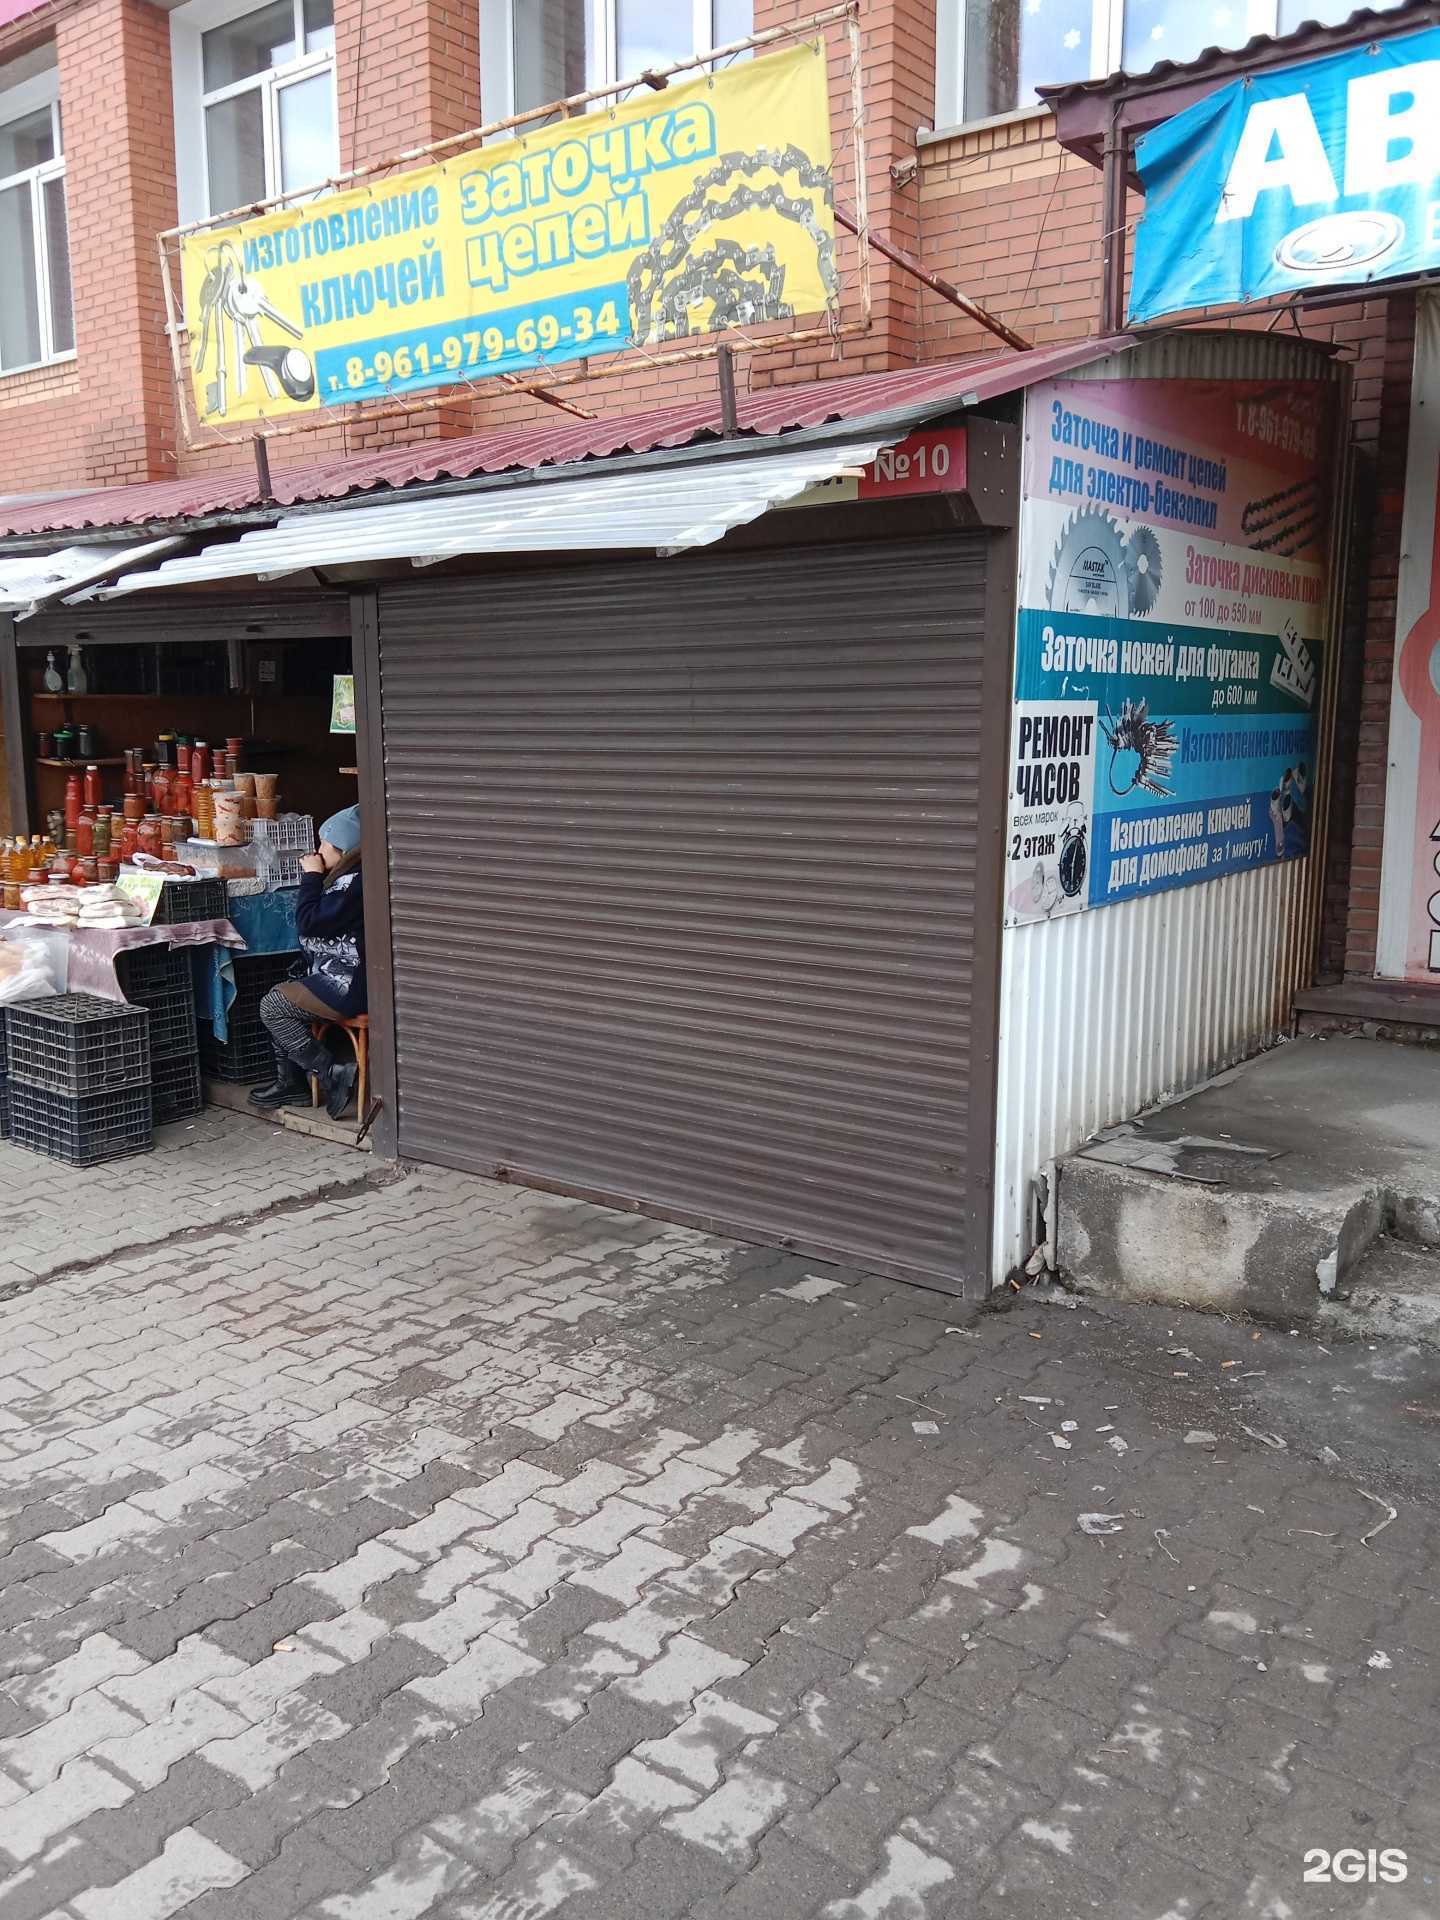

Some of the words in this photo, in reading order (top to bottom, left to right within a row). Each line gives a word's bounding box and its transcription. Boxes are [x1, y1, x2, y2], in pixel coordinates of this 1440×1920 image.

[466, 176, 650, 292] цепей
[300, 237, 444, 328] ключей
[346, 301, 620, 389] 8-961-979-69-34
[1051, 400, 1119, 460] Заточка
[1122, 432, 1132, 464] и
[1134, 435, 1187, 481] ремонт
[1188, 454, 1227, 493] цепей
[1049, 455, 1084, 495] для
[1087, 466, 1218, 529] электро-бензопил
[1185, 545, 1240, 592] Заточка
[1241, 565, 1301, 602] дисковых
[1184, 600, 1196, 616] от
[1199, 597, 1215, 618] 100
[1217, 605, 1230, 624] до
[1231, 602, 1247, 624] 550
[1249, 609, 1262, 625] мм
[1041, 626, 1118, 674] Заточка
[1121, 635, 1174, 677] ножей
[1176, 645, 1206, 682] для
[1206, 643, 1260, 682] фуганка
[1211, 688, 1225, 708] до
[1226, 685, 1243, 705] 600
[1243, 689, 1258, 705] мм
[1018, 715, 1093, 759] РЕМОНТ
[1181, 728, 1271, 764] Изготовление
[1016, 762, 1080, 807] ЧАСОВ
[1034, 811, 1059, 827] марок
[1110, 811, 1204, 852] Изготовление
[1207, 799, 1252, 835] ключей
[1012, 834, 1022, 861] 2
[1024, 833, 1056, 859] этаж
[1107, 856, 1138, 894] для
[1139, 841, 1209, 887] домофона
[1211, 848, 1222, 863] за
[1225, 841, 1230, 861] 1
